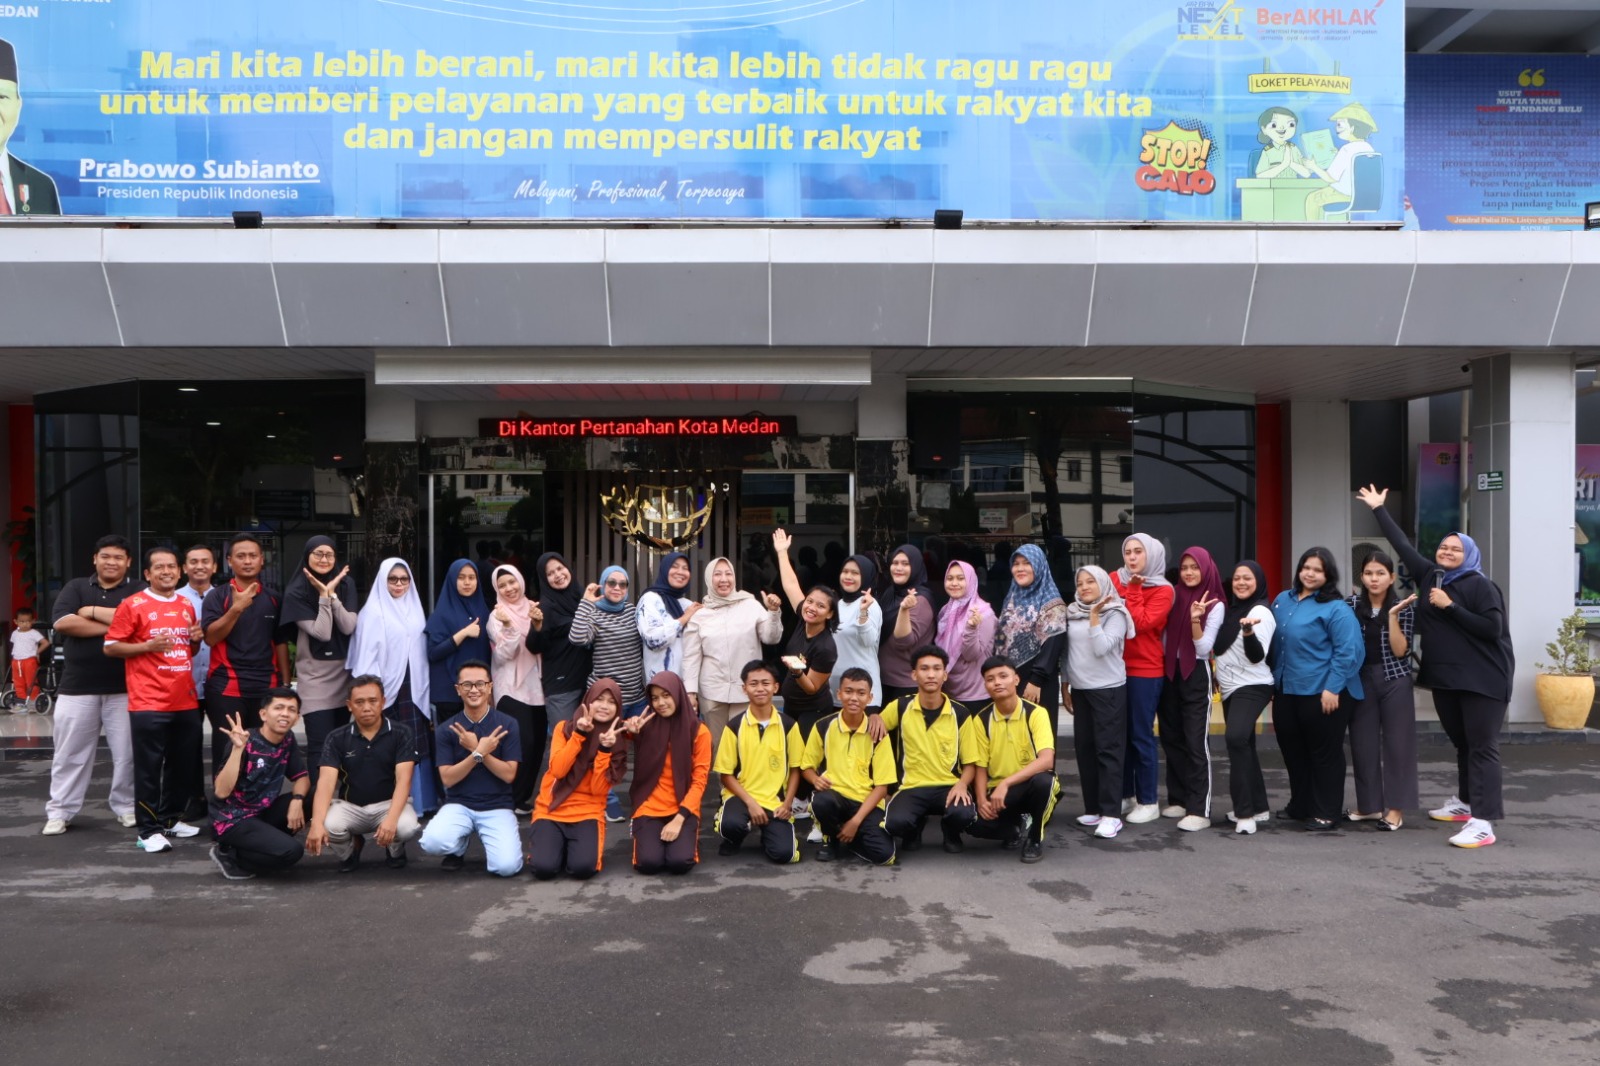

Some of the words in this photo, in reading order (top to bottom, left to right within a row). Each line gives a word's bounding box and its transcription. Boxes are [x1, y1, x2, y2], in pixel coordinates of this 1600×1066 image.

[1177, 7, 1245, 24] NEXT
[1256, 8, 1377, 26] BerAKHLAK
[1177, 24, 1244, 36] LEVEL
[141, 51, 219, 78] Mari
[231, 50, 302, 77] kita
[314, 50, 404, 76] lebih
[416, 50, 544, 81] berani,
[556, 52, 637, 77] mari
[649, 52, 718, 78] kita
[731, 52, 820, 78] lebih
[832, 52, 924, 79] tidak
[937, 60, 1018, 88] ragu
[1030, 60, 1112, 88] ragu
[1255, 78, 1287, 88] LOKET
[1289, 77, 1349, 89] PELAYANAN
[101, 89, 208, 115] untuk
[221, 87, 378, 113] memberi
[390, 88, 583, 120] pelayanan
[594, 93, 684, 121] yang
[696, 88, 827, 115] terbaik
[839, 90, 945, 115] untuk
[957, 91, 1073, 123] rakyat
[1084, 91, 1152, 117] kita
[344, 123, 414, 149] dan
[419, 123, 552, 156] jangan
[565, 124, 793, 157] mempersulit
[804, 125, 921, 158] rakyat
[1140, 133, 1212, 170] STOP!
[79, 158, 196, 178] Prabowo
[203, 159, 320, 179] Subianto
[1135, 165, 1217, 195] CALO
[97, 186, 160, 199] Presiden
[164, 186, 226, 201] Republik
[230, 186, 299, 199] Indonesia
[513, 179, 579, 204] Melayani,
[587, 179, 667, 204] Profesional,
[676, 179, 745, 204] Terpecaya
[1482, 200, 1509, 210] tanpa
[1511, 200, 1553, 210] pandang
[500, 421, 516, 436] Di
[520, 421, 575, 436] Kantor
[581, 419, 674, 435] Pertanahan
[679, 419, 718, 434] Kota
[723, 419, 779, 434] Medan
